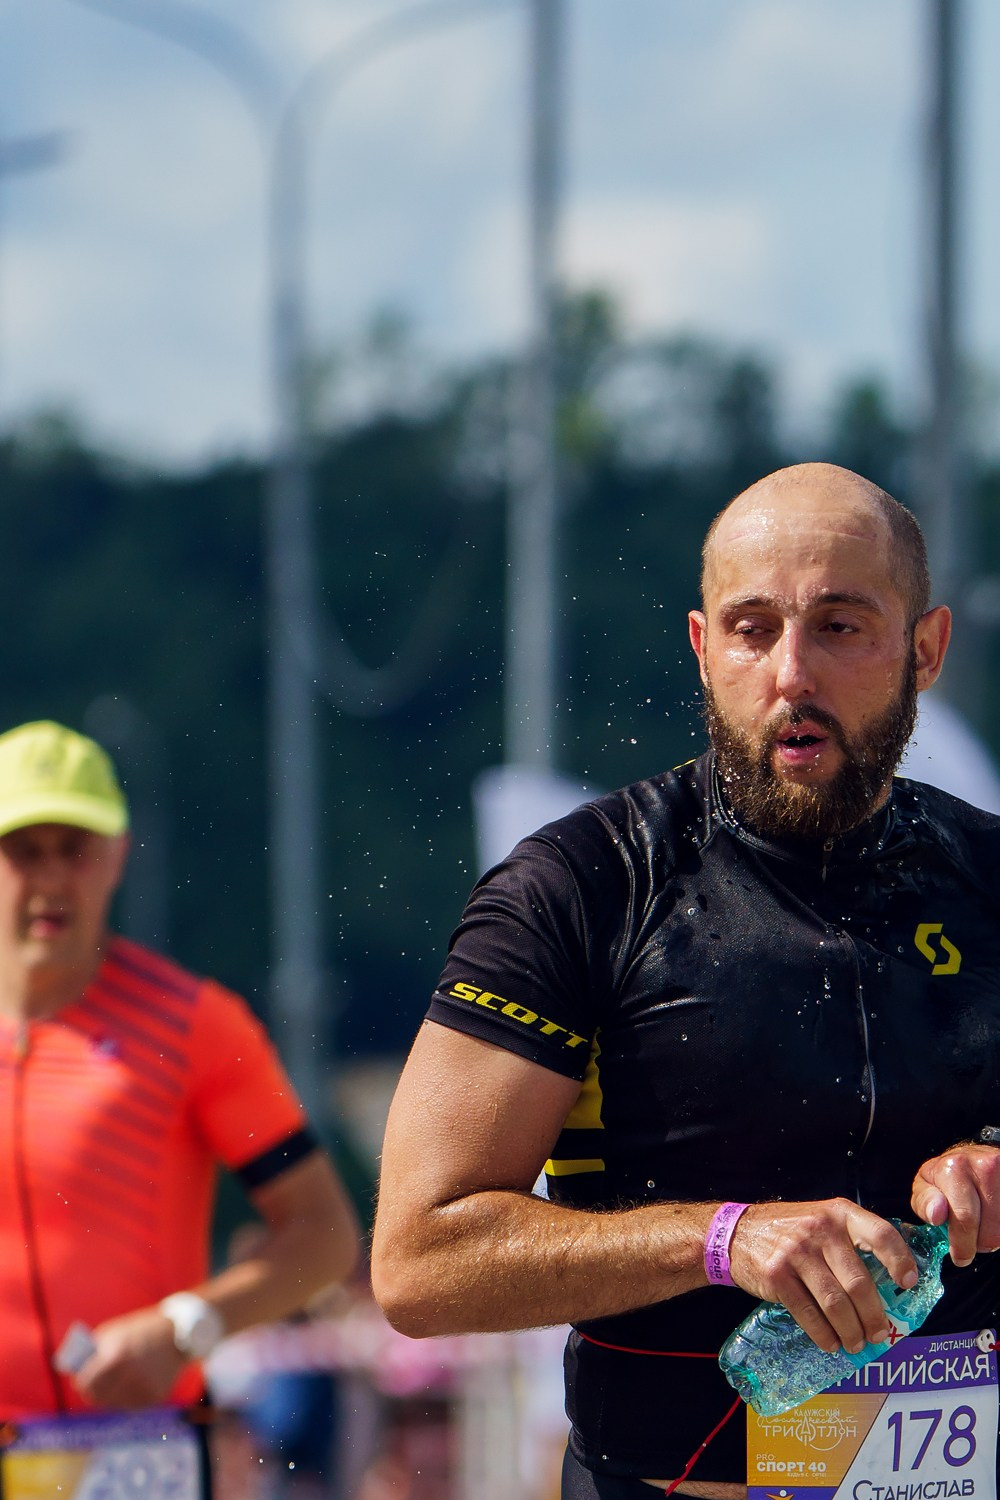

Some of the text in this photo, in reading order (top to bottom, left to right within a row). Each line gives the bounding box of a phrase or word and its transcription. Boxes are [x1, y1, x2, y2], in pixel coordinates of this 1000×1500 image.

[449, 982, 589, 1048] SCOTT
[928, 1338, 978, 1353] ДИСТАНЦИ
[836, 1354, 991, 1387] МПИЙСКАЯ
[887, 1404, 977, 1473] 178
[756, 1461, 827, 1472] СПОРТ 40
